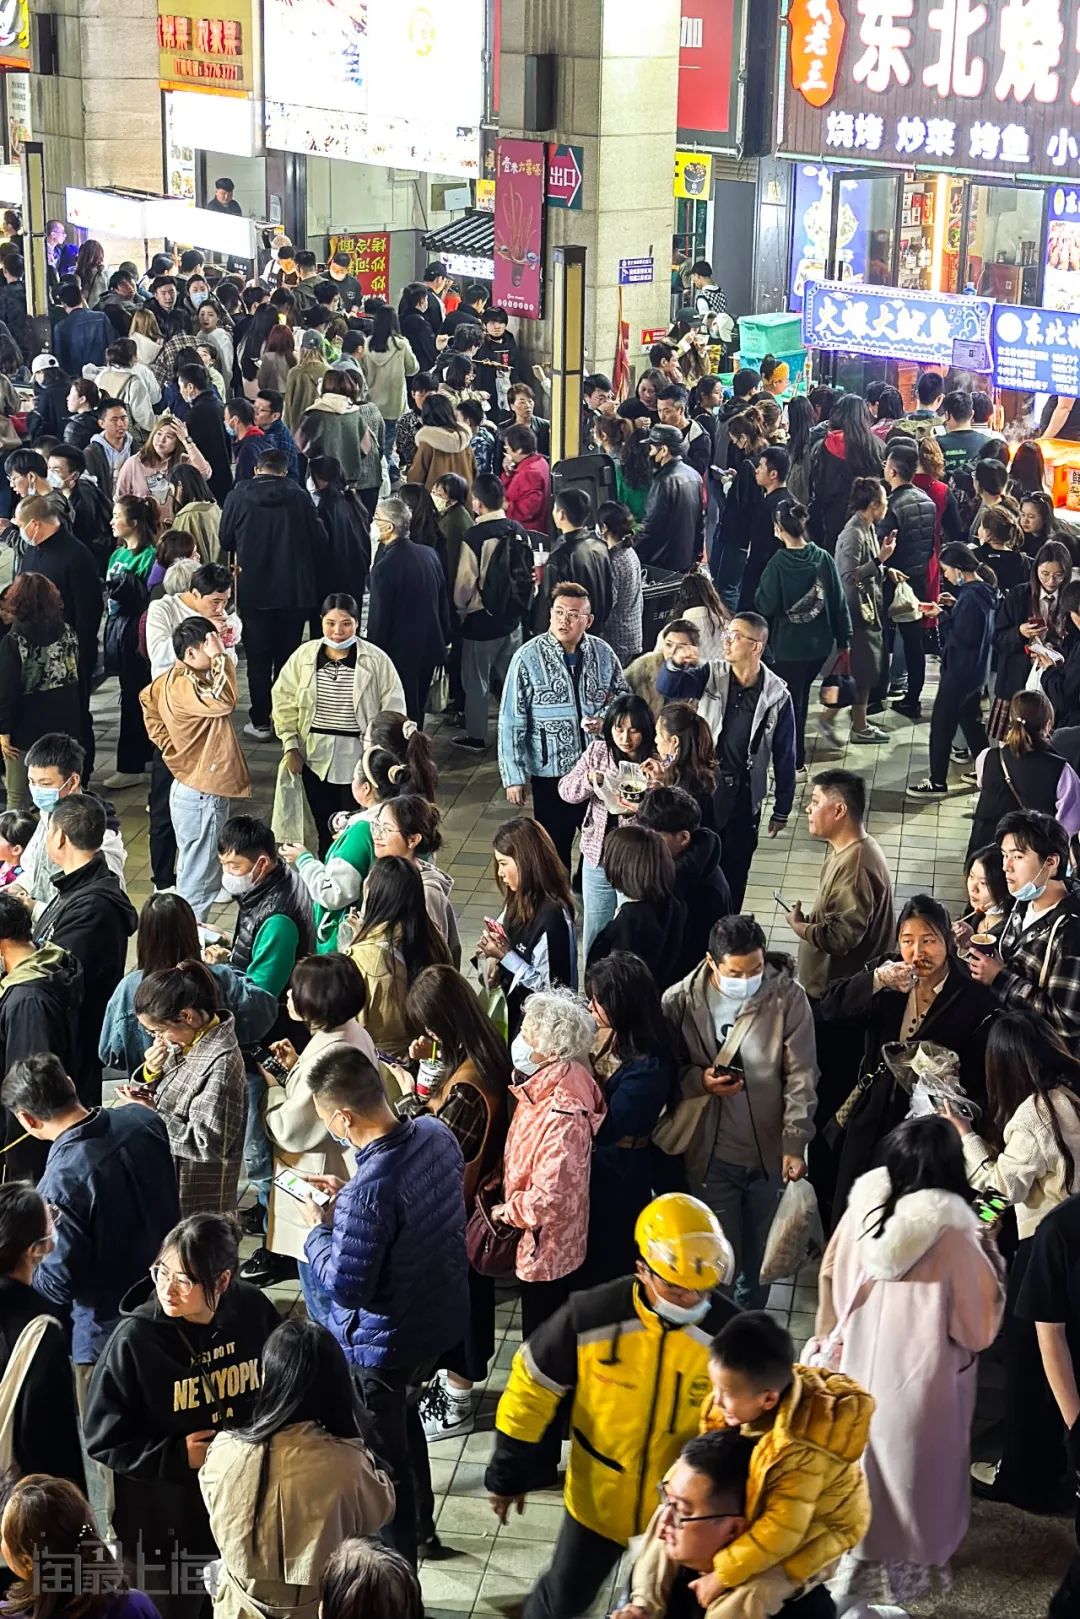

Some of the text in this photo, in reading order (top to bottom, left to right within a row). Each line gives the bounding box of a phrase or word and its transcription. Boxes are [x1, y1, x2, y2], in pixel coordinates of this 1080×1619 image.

[852, 0, 1080, 105] 东北烧
[826, 110, 1080, 167] 烧烤 炒菜 烤鱼 小
[550, 166, 577, 188] 出口
